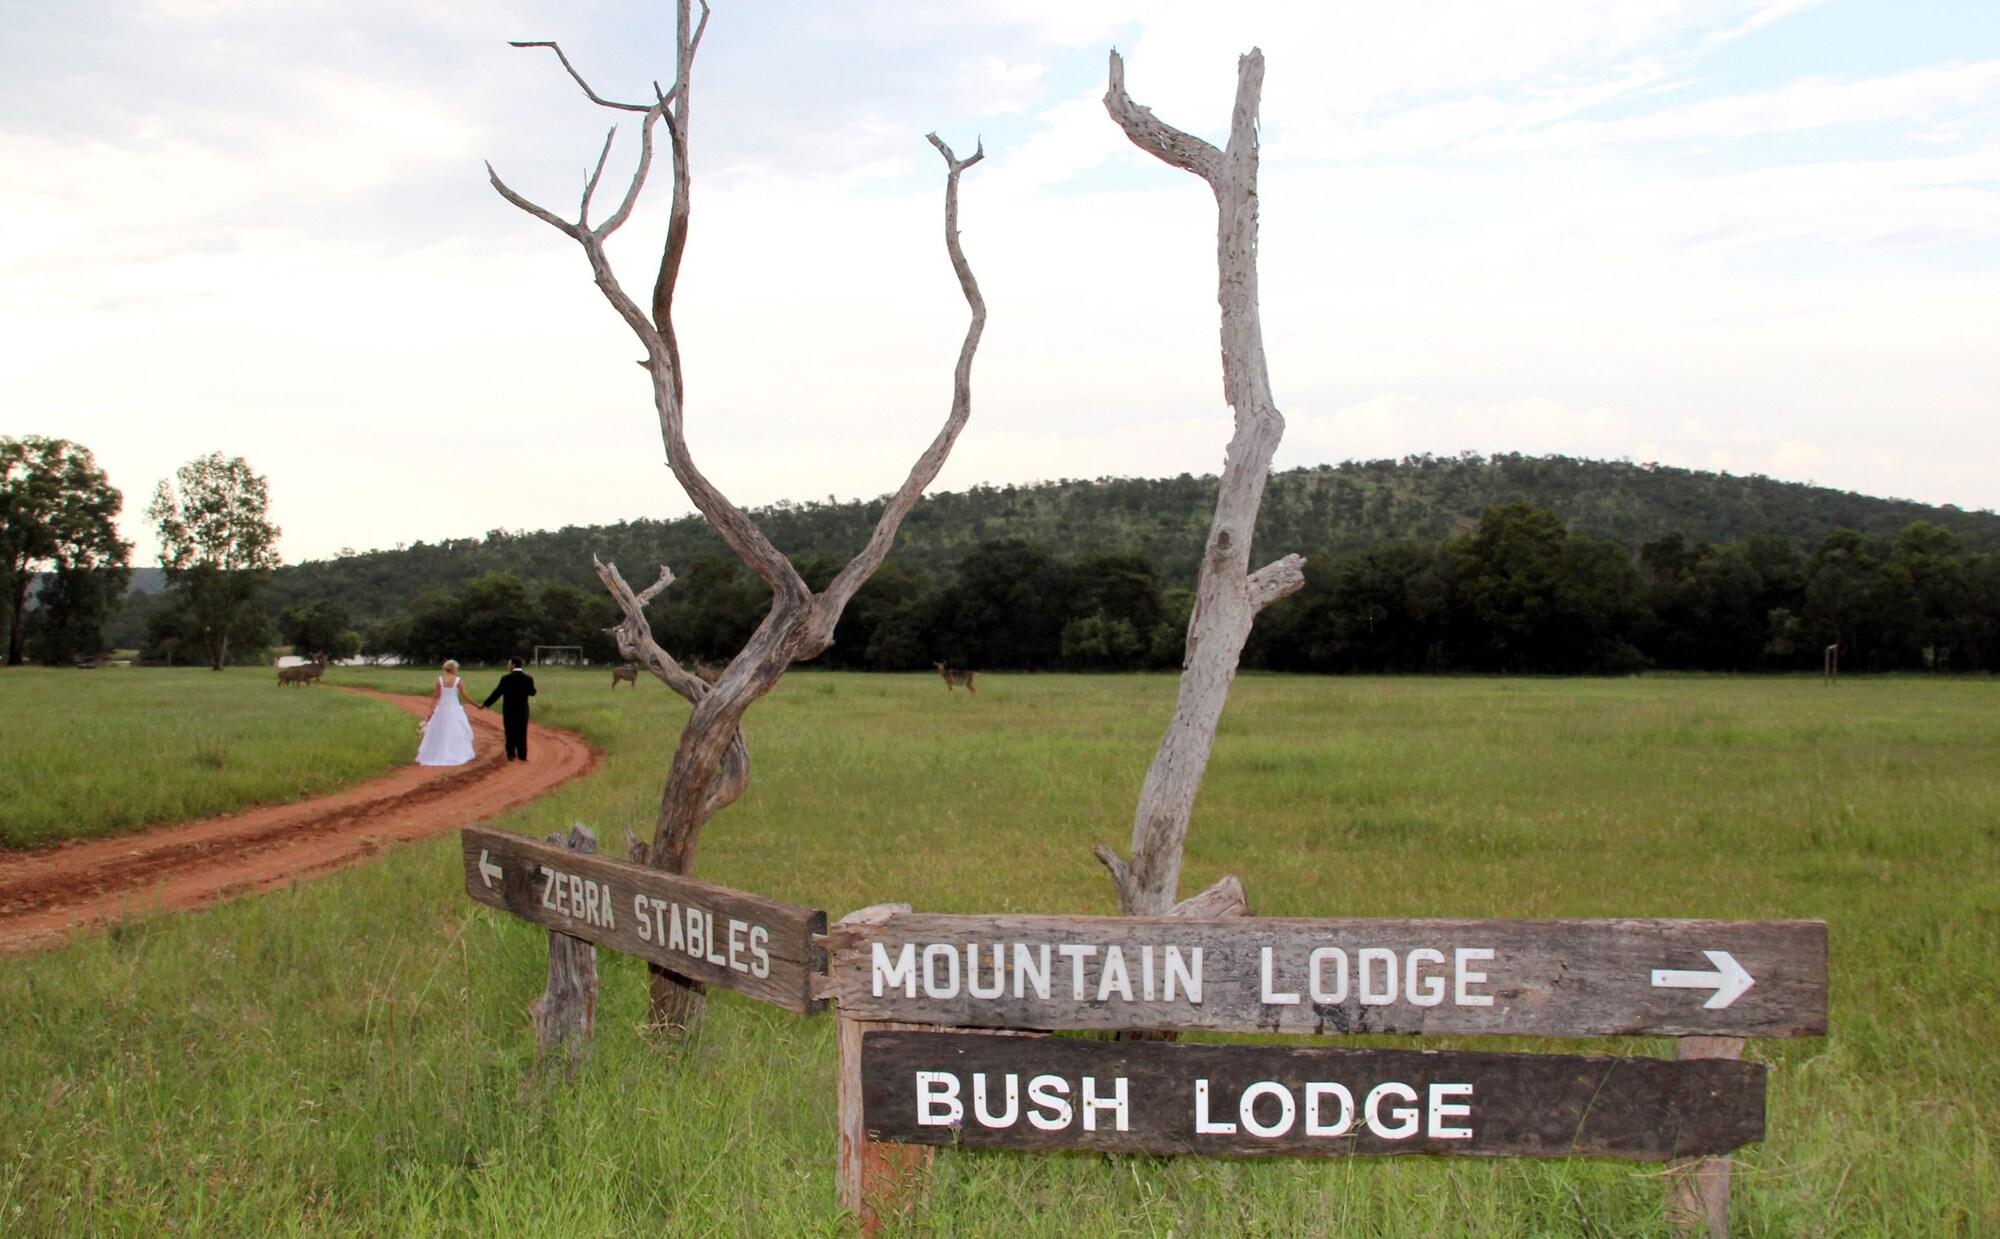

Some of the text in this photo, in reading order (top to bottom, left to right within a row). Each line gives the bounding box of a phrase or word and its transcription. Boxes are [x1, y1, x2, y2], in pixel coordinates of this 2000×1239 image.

[540, 866, 770, 979] ZEBRA STABLES
[871, 942, 1495, 1006] MOUNTAIN LODGE
[916, 1071, 1473, 1139] BUSH LODGE
